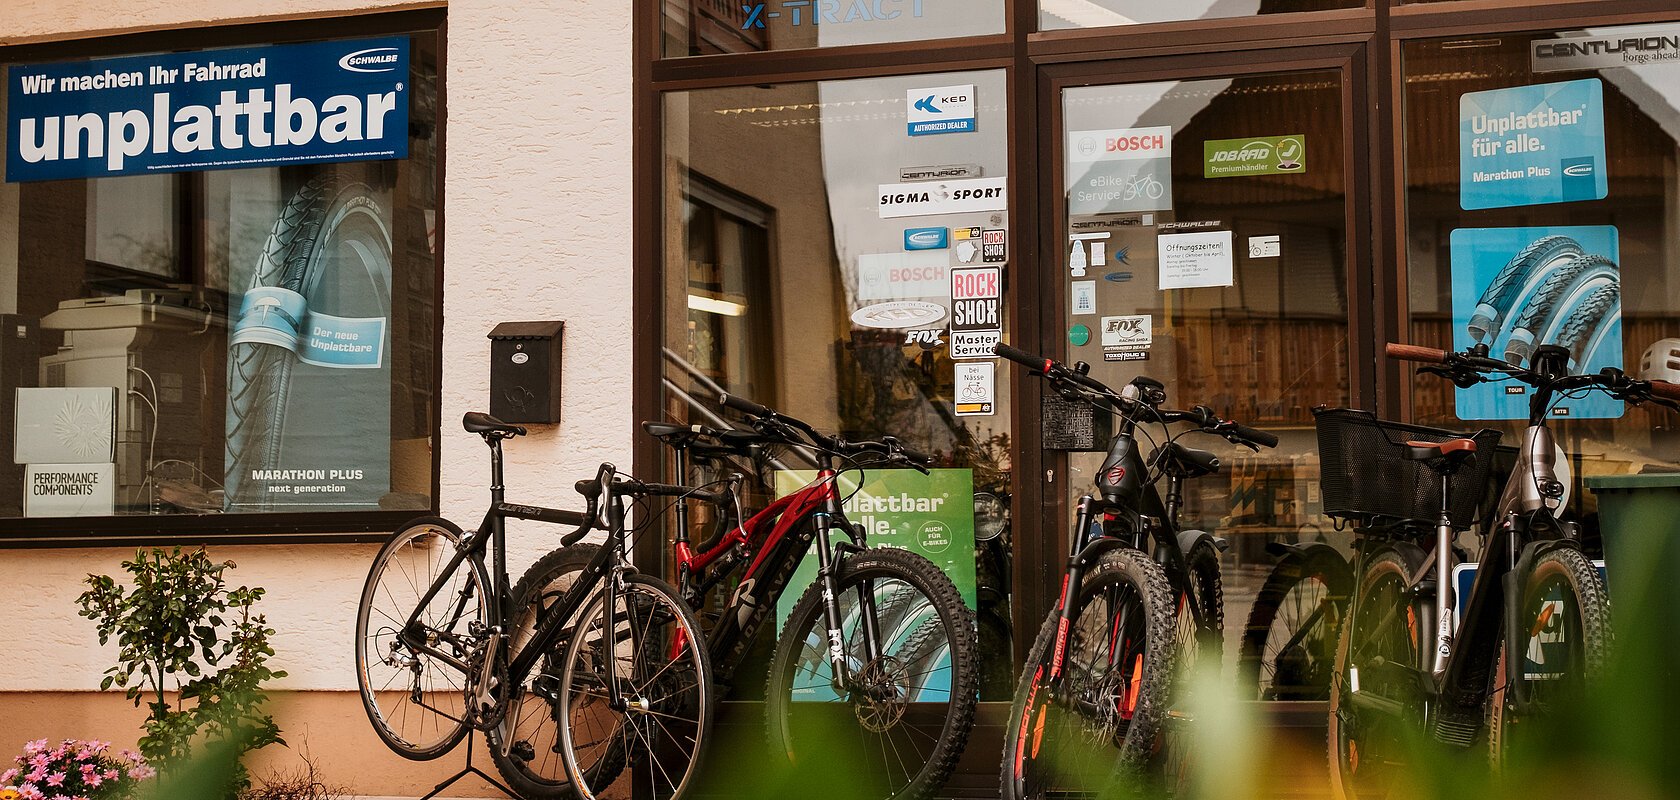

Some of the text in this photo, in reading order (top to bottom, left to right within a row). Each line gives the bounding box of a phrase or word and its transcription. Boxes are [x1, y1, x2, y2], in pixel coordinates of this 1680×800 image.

[1536, 36, 1678, 58] CENTURION
[348, 54, 398, 65] SCHWALBE
[1622, 49, 1678, 64] Forge ahead
[21, 57, 266, 94] Wir machen Ihr Fahrrad
[941, 95, 967, 104] KED
[914, 121, 968, 132] AUTHORIZED DEALER
[1105, 135, 1164, 152] BOSCH
[1471, 133, 1545, 158] für alle.
[1208, 148, 1270, 162] JOBRAD
[1211, 164, 1268, 173] Premiumhändler
[1473, 166, 1551, 182] Marathon Plus
[1090, 176, 1122, 187] eBike
[880, 187, 1002, 205] SIGMA SPORT
[1077, 191, 1121, 202] Service
[1157, 220, 1221, 229] SCHWALBE
[984, 233, 1003, 244] ROCK
[984, 245, 1004, 256] SHOX
[889, 266, 944, 282] BOSCH
[954, 273, 997, 298] ROCK
[954, 299, 997, 326] SHOX
[313, 326, 359, 340] Der neue
[1106, 318, 1144, 334] FOX
[905, 330, 945, 346] FOX
[955, 335, 998, 345] Master
[310, 338, 373, 353] Unplattbare
[34, 473, 98, 484] PERFORMANCE
[252, 469, 364, 480] MARATHON PLUS
[33, 484, 93, 496] COMPONENTS
[269, 483, 346, 494] next generation
[922, 539, 948, 547] E-BIKES
[734, 554, 796, 655] RAYMON
[828, 628, 845, 663] FOX
